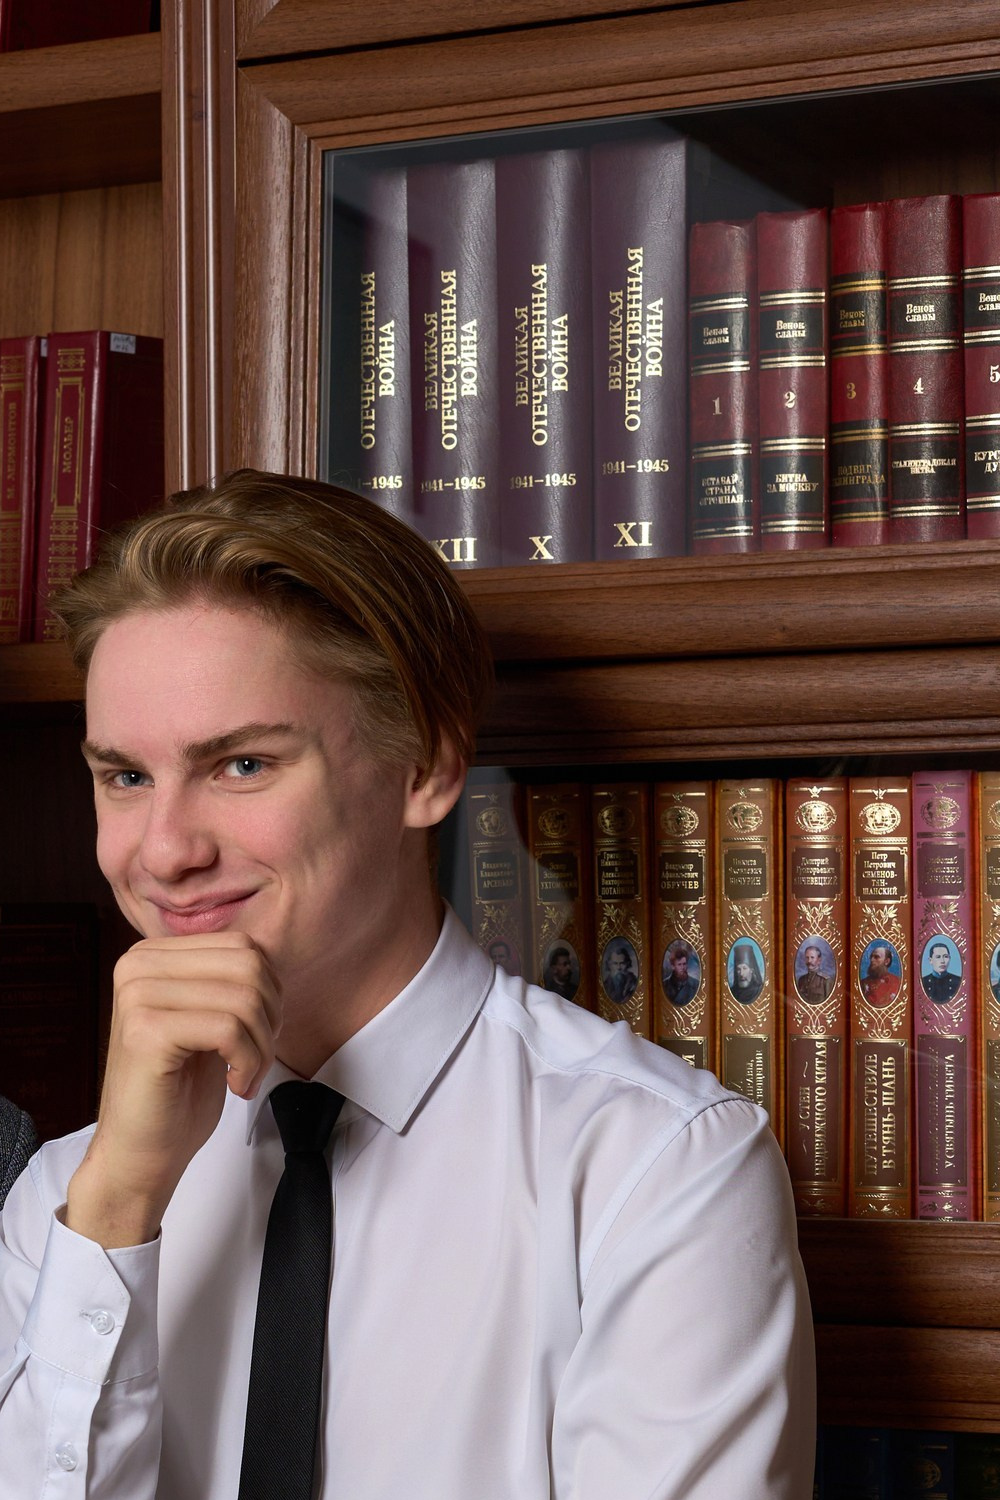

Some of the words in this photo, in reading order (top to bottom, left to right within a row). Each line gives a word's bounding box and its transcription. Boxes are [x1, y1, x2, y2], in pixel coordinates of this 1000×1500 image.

[839, 310, 866, 320] Венок
[905, 304, 935, 315] Венок
[905, 312, 936, 323] славы
[702, 327, 729, 337] Венок
[776, 320, 806, 331] Венок
[839, 317, 866, 329] славы
[608, 289, 624, 391] ВЕЛИКАЯ
[624, 246, 644, 432] ОТЕЧЕСТВЕННАЯ
[641, 297, 664, 377] ВОЙНА
[775, 329, 807, 339] славы
[360, 271, 376, 450] ОТЕЧЕСТВЕННАЯ
[375, 319, 395, 397] ВОЙНА
[424, 311, 438, 412] ВЕЛИКАЯ
[441, 269, 458, 451] ОТЕЧЕСТВЕННАЯ
[457, 318, 478, 397] ВОЙНА
[514, 305, 529, 407] ВЕЛИКАЯ
[531, 263, 548, 446] ОТЕЧЕСТВЕННАЯ
[547, 313, 569, 392] ВОЙНА
[989, 365, 1000, 383] 5
[846, 382, 857, 400] 3
[912, 377, 925, 395] 4
[712, 397, 723, 416] 1
[784, 391, 797, 409] 2
[7, 402, 17, 481] ЛЕРМОНТОВ
[62, 416, 74, 474] МОЛЬЕР
[601, 458, 670, 475] 1941-1945
[838, 464, 873, 476] ПОДВИГ
[767, 484, 778, 493] ЗА
[778, 482, 820, 493] МОСКВУ
[775, 473, 809, 483] БИТВА
[7, 485, 16, 500] М.
[705, 484, 738, 496] СТРАНА
[613, 521, 653, 548] XI
[428, 537, 478, 563] XII
[528, 535, 554, 561] X
[863, 861, 896, 870] Петрович
[871, 851, 889, 861] Петр
[660, 880, 700, 889] ОБРУЧЕВ
[862, 886, 898, 896] ШАНСКИЙ
[814, 1041, 828, 1084] КИТАЯ
[944, 1054, 955, 1101] ТИБЕТА
[799, 1086, 811, 1120] СТЕН
[882, 1056, 896, 1157] ТЯНЬ-ШАНЬ
[864, 1053, 878, 1176] ПУТЕШЕСТВИЕ
[814, 1087, 828, 1177] НЕДВИЖНОГО
[944, 1102, 956, 1159] СВЯТЫНЬ
[882, 1162, 896, 1170] В
[944, 1160, 956, 1169] У
